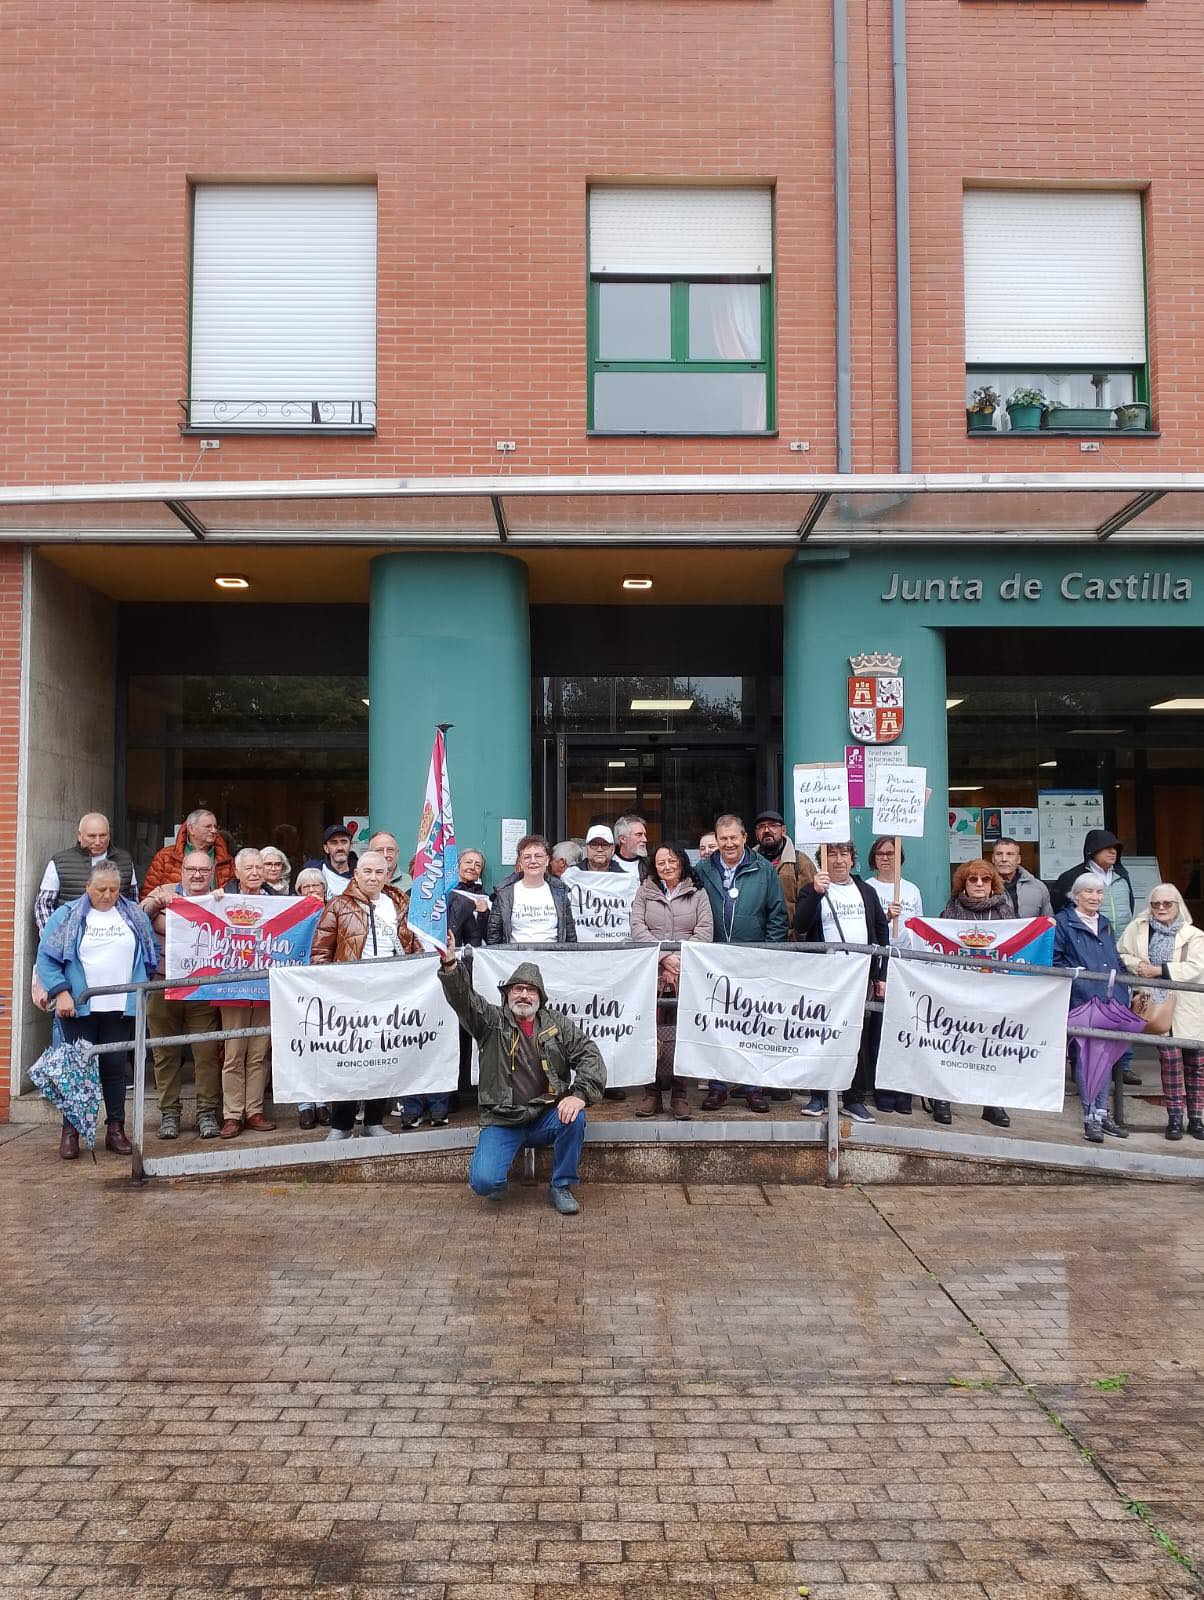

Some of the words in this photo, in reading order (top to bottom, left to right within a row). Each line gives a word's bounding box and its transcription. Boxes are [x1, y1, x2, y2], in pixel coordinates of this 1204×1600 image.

[881, 573, 984, 601] Junta
[1000, 573, 1044, 600] de
[1061, 572, 1193, 601] Castilla
[260, 933, 294, 955] día
[199, 951, 249, 970] mucho
[386, 1003, 426, 1030] día
[585, 993, 625, 1020] día
[791, 994, 832, 1023] día
[694, 1012, 710, 1032] es
[714, 1013, 779, 1038] mucho
[991, 1015, 1030, 1041] día
[290, 1038, 306, 1057] es
[309, 1029, 374, 1055] mucho
[738, 1041, 799, 1054] #ONCOBIERZO
[897, 1030, 914, 1049] es
[918, 1031, 978, 1056] mucho
[336, 1057, 399, 1069] #ONCOBIERZO
[940, 1060, 997, 1073] #ONCOBIERZO
